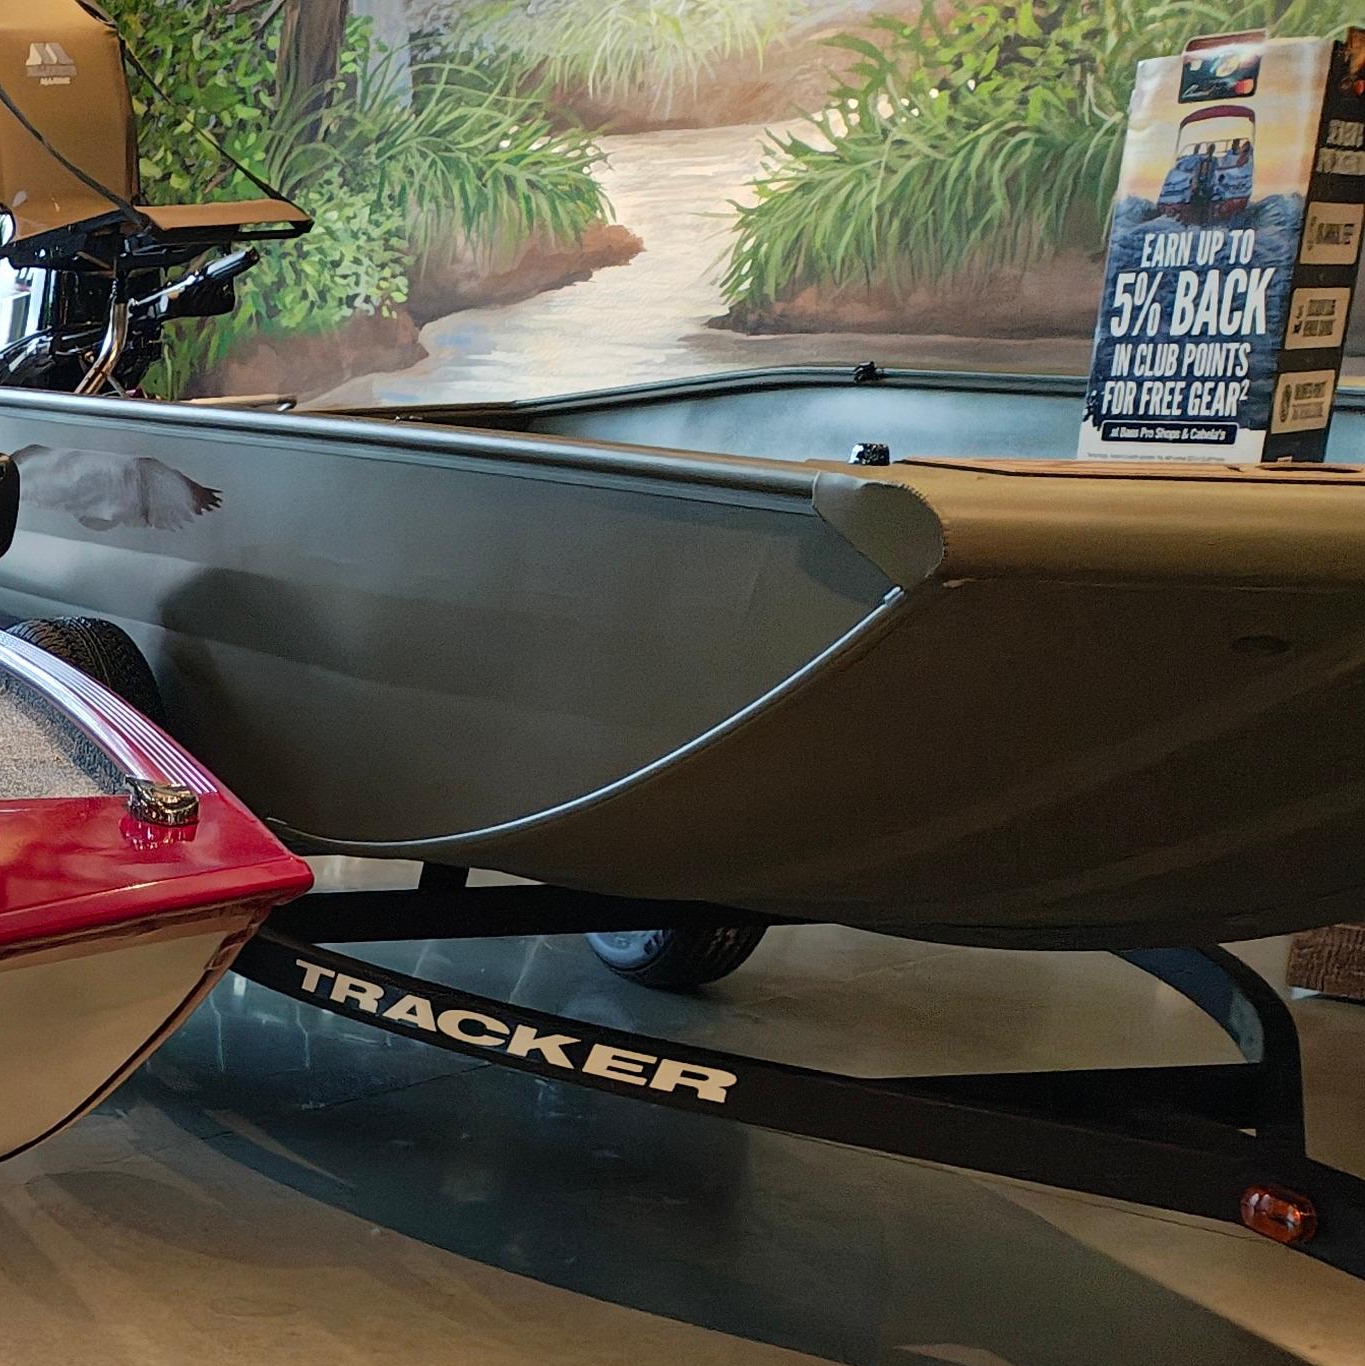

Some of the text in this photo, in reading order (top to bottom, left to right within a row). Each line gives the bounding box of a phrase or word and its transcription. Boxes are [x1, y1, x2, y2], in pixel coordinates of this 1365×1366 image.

[1141, 229, 1255, 268] EARN UP TO
[1110, 267, 1275, 337] 5% BACK
[1111, 342, 1251, 377] IN CLUB POINTS
[1102, 381, 1137, 415] FOR
[1139, 381, 1186, 416] FREE
[1120, 426, 1139, 438] Bass
[1140, 427, 1154, 438] Pro
[1155, 427, 1181, 440] Shops
[1181, 428, 1189, 439] &
[1190, 428, 1226, 440] Cabela's
[295, 958, 738, 1104] TRACKER
